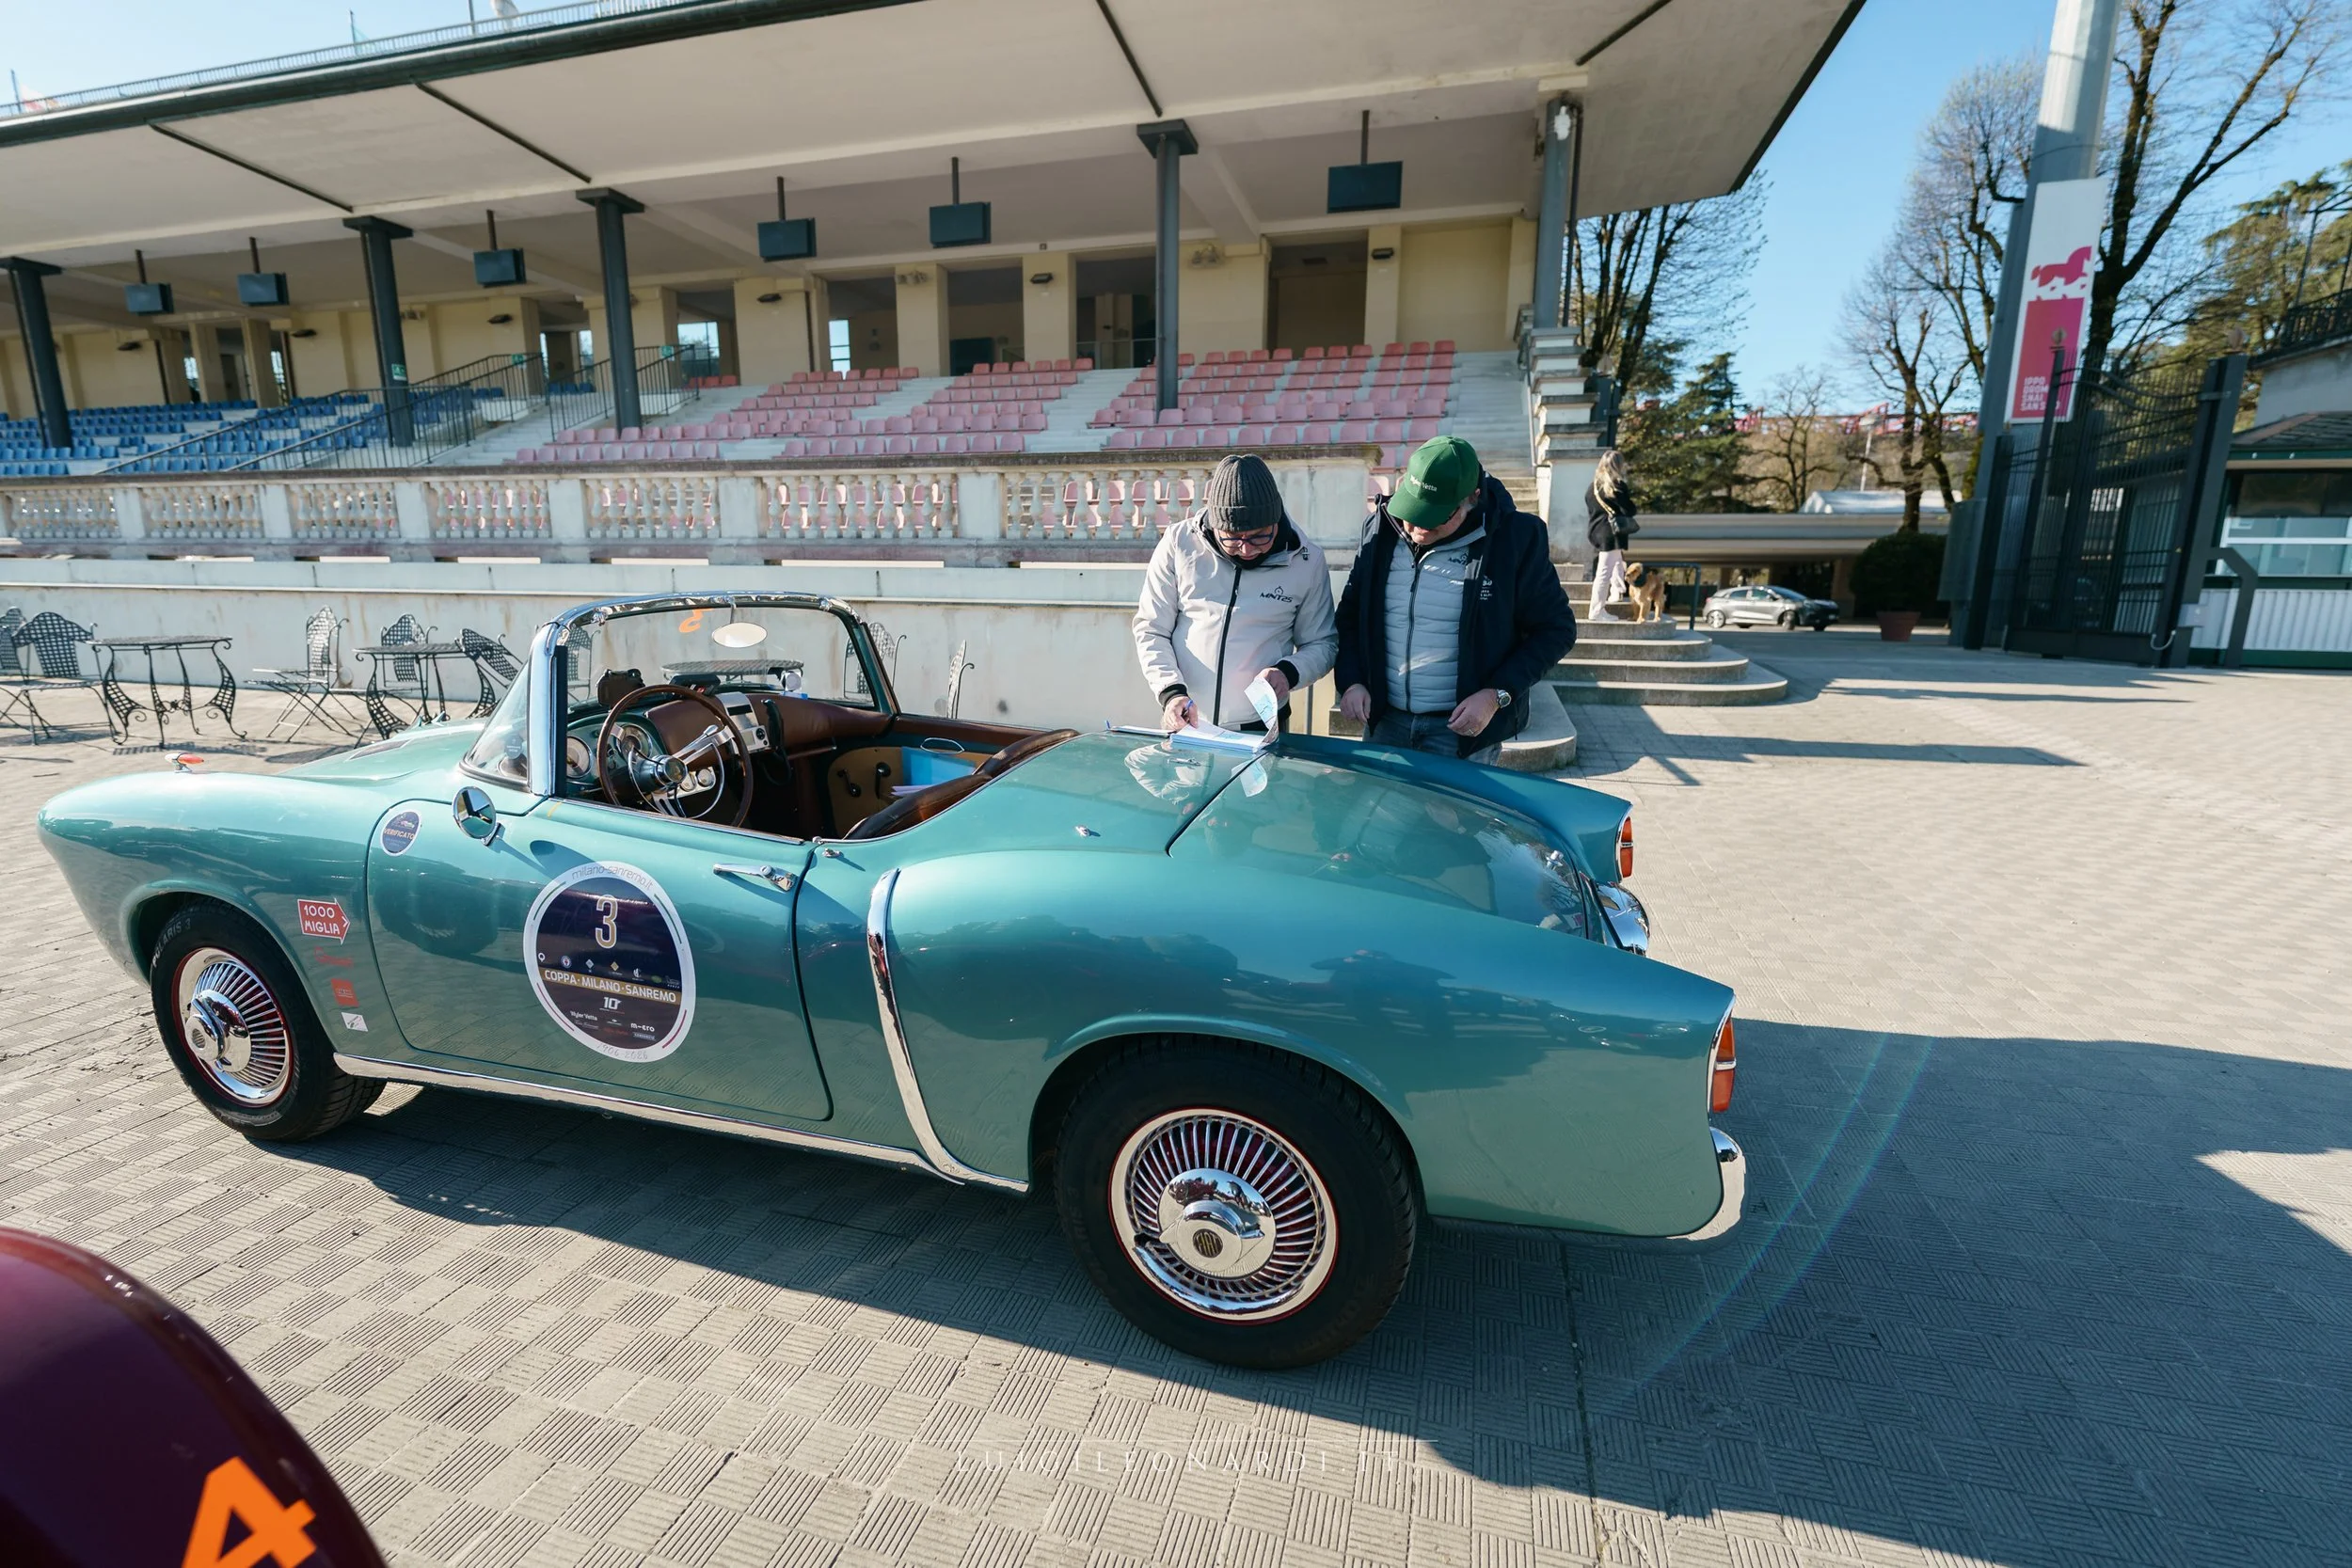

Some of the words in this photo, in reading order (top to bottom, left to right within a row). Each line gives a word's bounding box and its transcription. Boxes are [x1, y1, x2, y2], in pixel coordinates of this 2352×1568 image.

[2023, 385, 2050, 393] DROM
[384, 828, 416, 840] VERIFICATO
[572, 864, 654, 891] milano-sanremo.it
[304, 904, 335, 919] 1000
[595, 894, 618, 949] 3
[304, 920, 341, 934] MIGLIA
[544, 970, 577, 986] COPPA
[625, 984, 676, 1003] SANREMO
[1196, 1231, 1223, 1257] FIAT
[181, 1456, 317, 1568] 4
